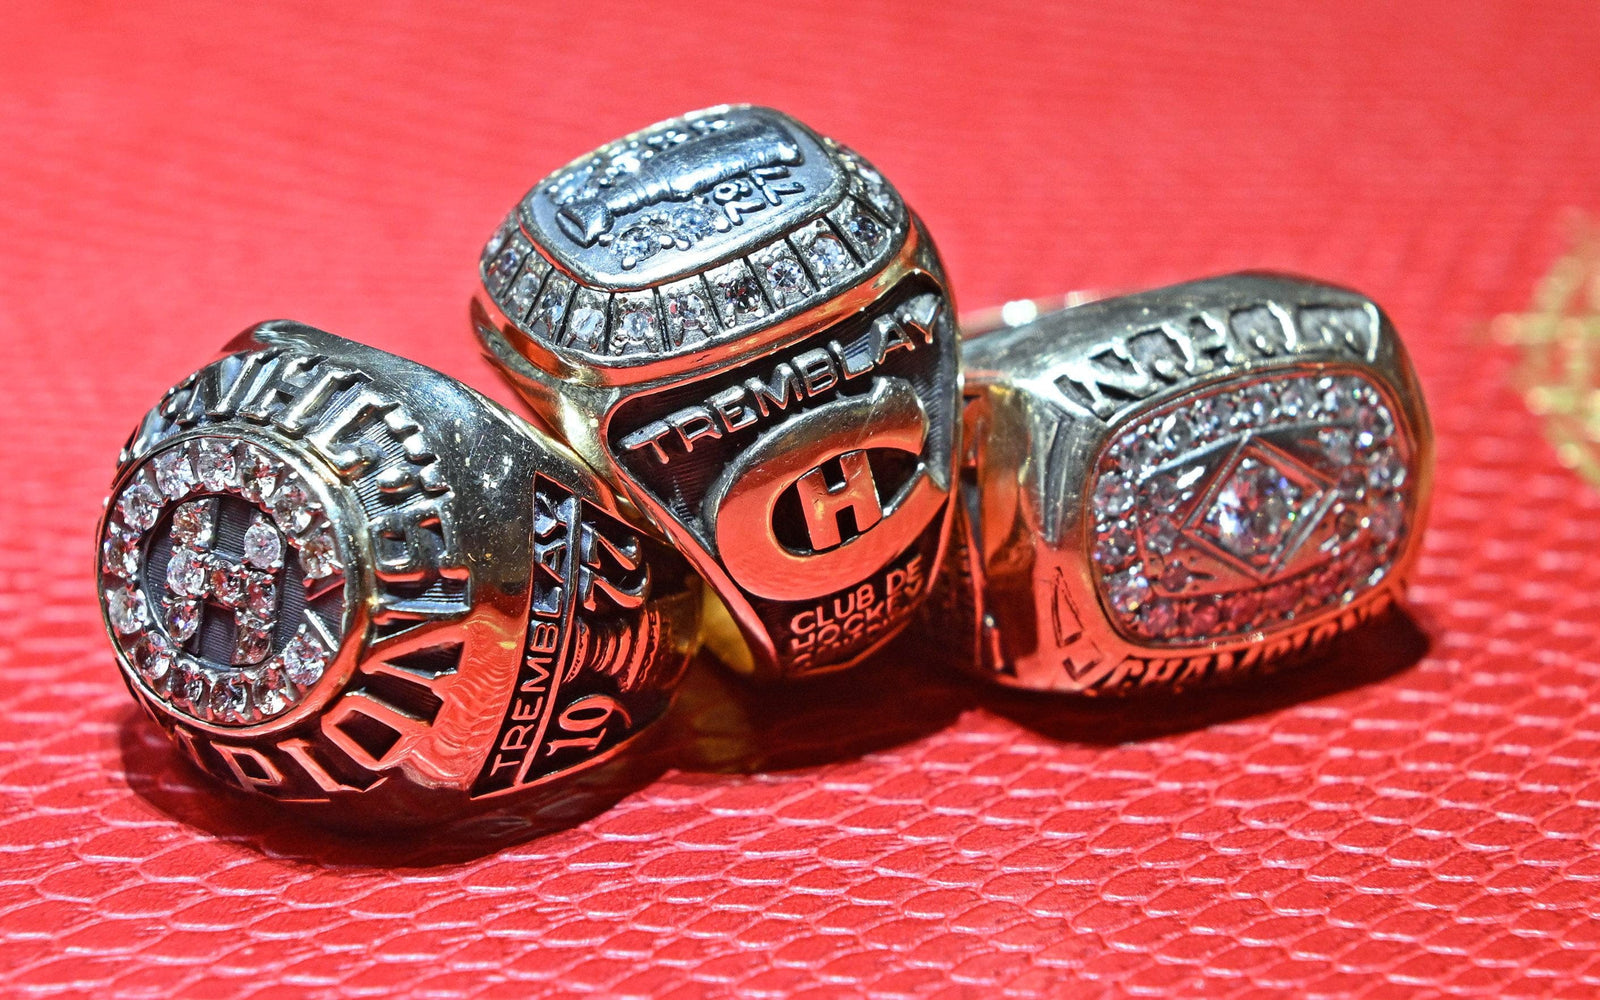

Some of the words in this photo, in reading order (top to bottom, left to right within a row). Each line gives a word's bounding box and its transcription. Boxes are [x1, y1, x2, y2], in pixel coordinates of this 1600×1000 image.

[618, 291, 942, 464] TREMBLAY
[576, 520, 651, 613] 77
[790, 583, 875, 635] CLUB
[886, 553, 922, 596] DE
[490, 490, 577, 778] TREMBLAY
